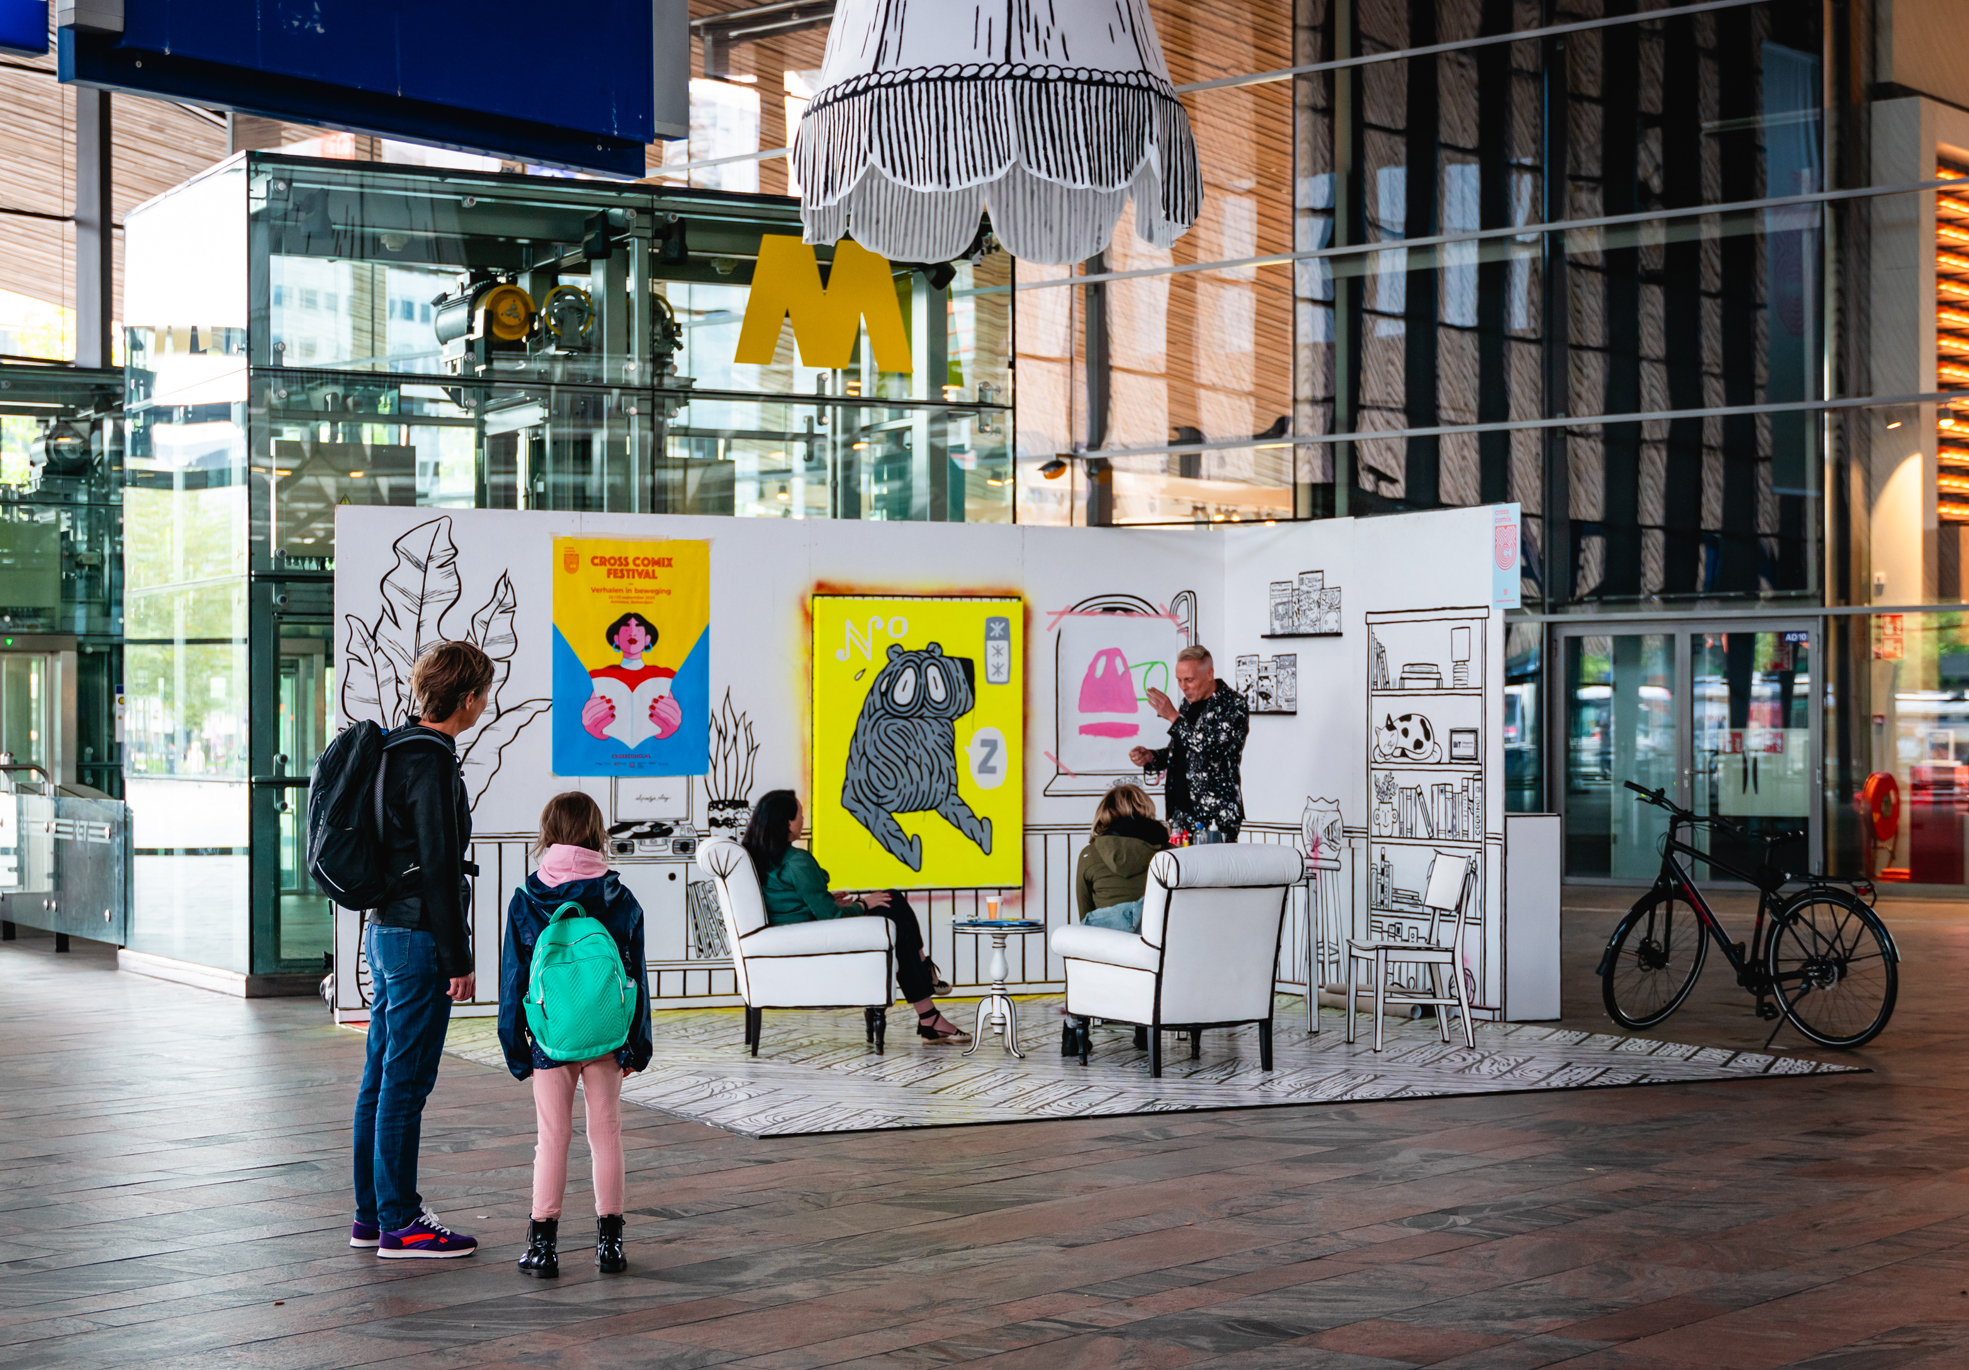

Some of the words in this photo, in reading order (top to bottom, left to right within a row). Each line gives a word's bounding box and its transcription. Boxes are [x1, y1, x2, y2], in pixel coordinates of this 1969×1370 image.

[734, 234, 913, 373] M
[590, 556, 630, 567] CROSS
[632, 557, 673, 568] COMIX
[606, 568, 658, 579] FESTIVAL
[634, 587, 671, 595] beweging
